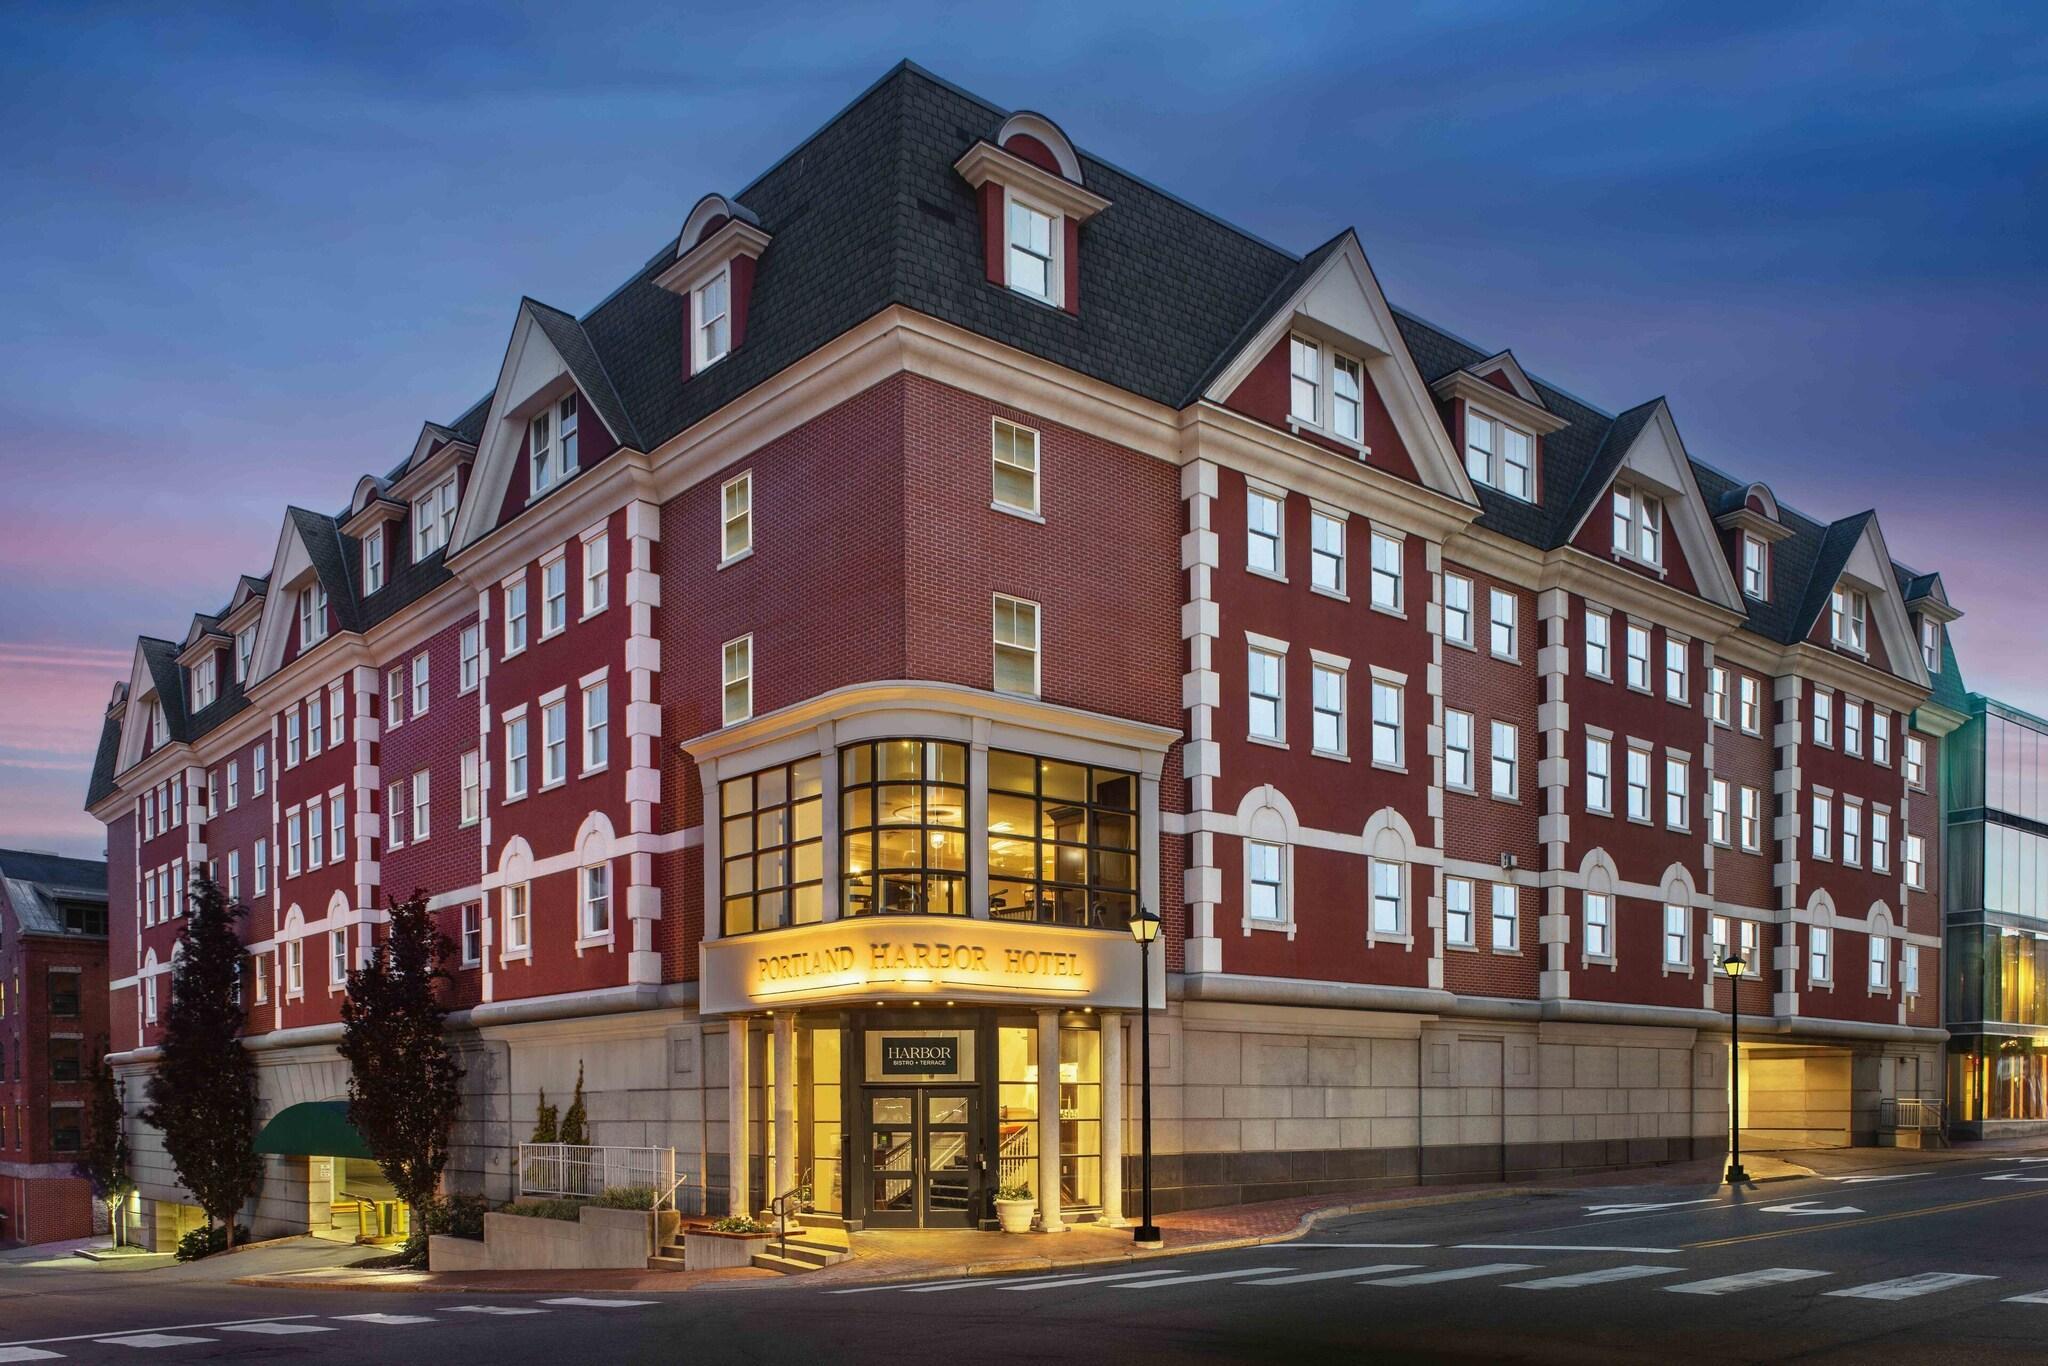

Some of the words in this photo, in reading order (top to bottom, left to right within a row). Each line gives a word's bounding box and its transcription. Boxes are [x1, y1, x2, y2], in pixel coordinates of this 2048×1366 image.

[757, 945, 855, 981] PORTLAND
[869, 942, 989, 971] HARBOR
[1004, 949, 1084, 976] HOTEL
[888, 1047, 952, 1059] HARBOR
